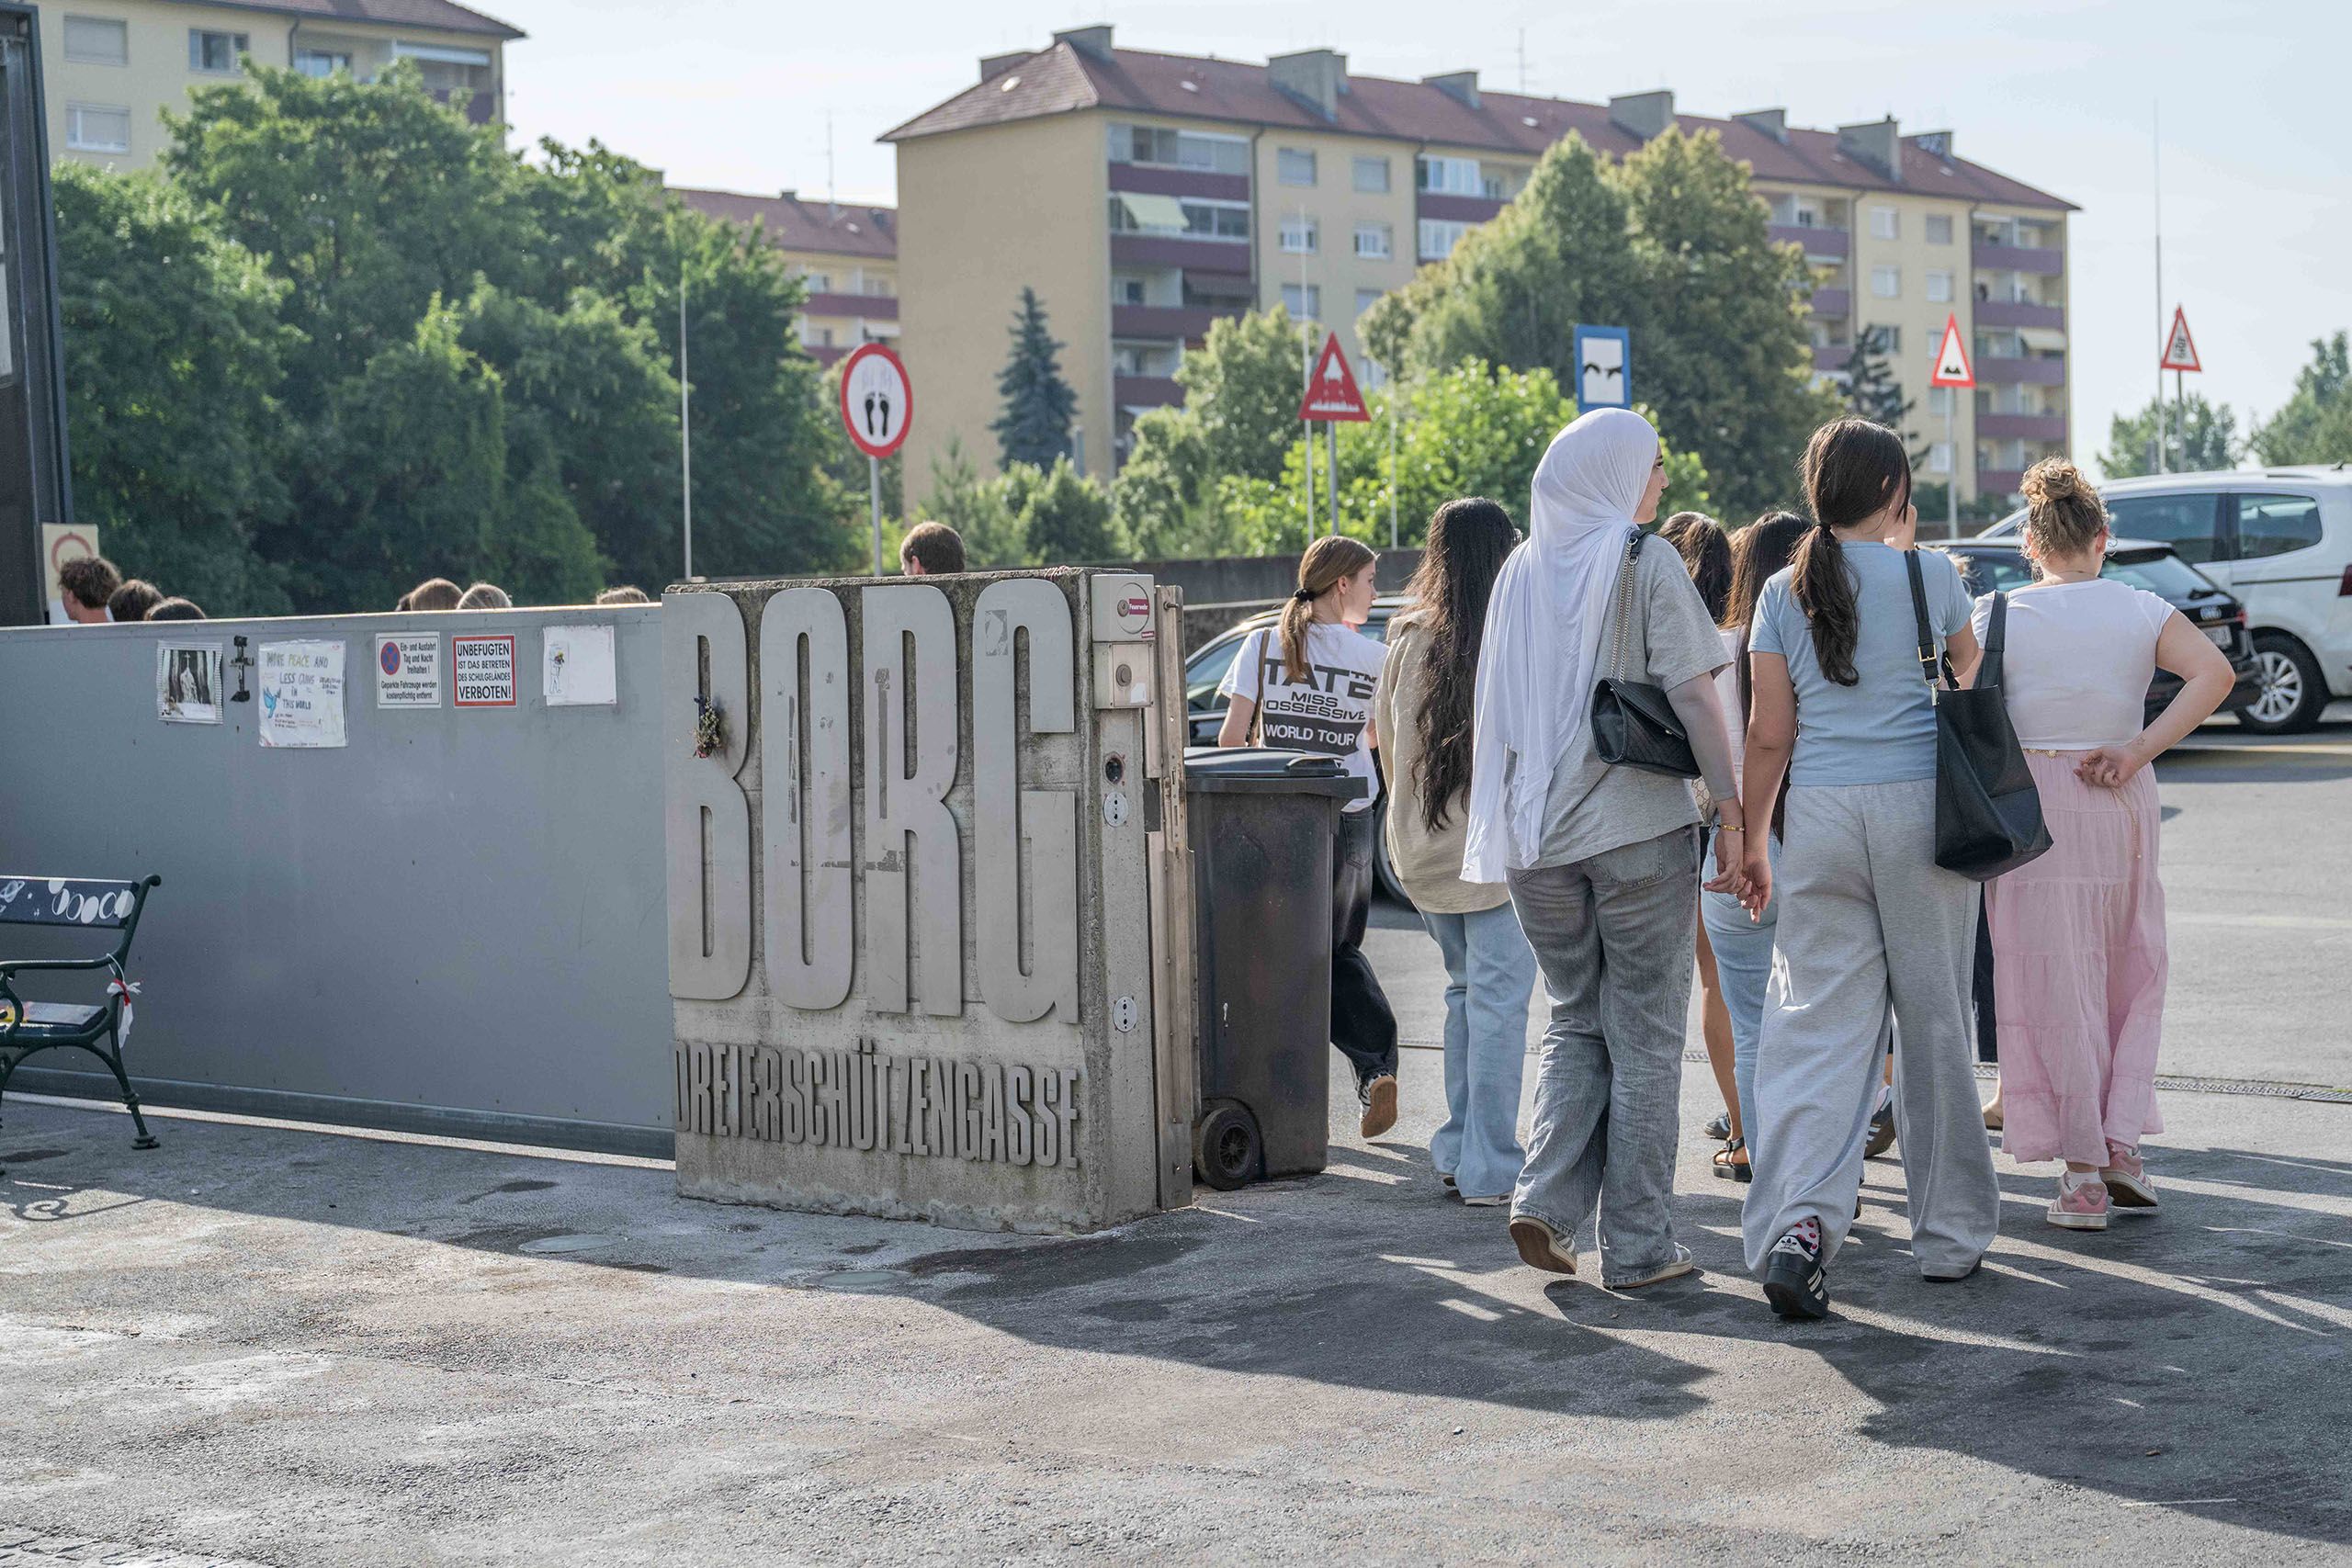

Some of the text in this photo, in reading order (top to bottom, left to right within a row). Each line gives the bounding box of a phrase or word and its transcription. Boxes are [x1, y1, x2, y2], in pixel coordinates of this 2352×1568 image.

[418, 642, 436, 651] Ausfahrt
[457, 643, 510, 657] UNBEFUGTEN
[288, 652, 310, 668] PEACE
[313, 655, 329, 669] AND
[403, 653, 434, 664] Tag und Nacht
[458, 660, 510, 669] IST DAS BETRETEN
[407, 665, 427, 674] freihalten
[279, 671, 296, 684] LESS
[458, 671, 511, 682] DES SCHULGELÄNDES
[380, 680, 437, 691] Geparkte Fahrzeuge werden
[458, 685, 512, 699] VERBOTEN!
[386, 691, 416, 701] kostenpflichtig
[1291, 691, 1339, 708] MISS
[282, 698, 311, 710] THIS WORLD
[1263, 700, 1366, 721] OSSESSIVE
[1264, 723, 1355, 746] WORLD TOUR
[662, 579, 1080, 1024] BORG
[675, 1038, 1079, 1168] DREIERSCHÜTZENGASSE
